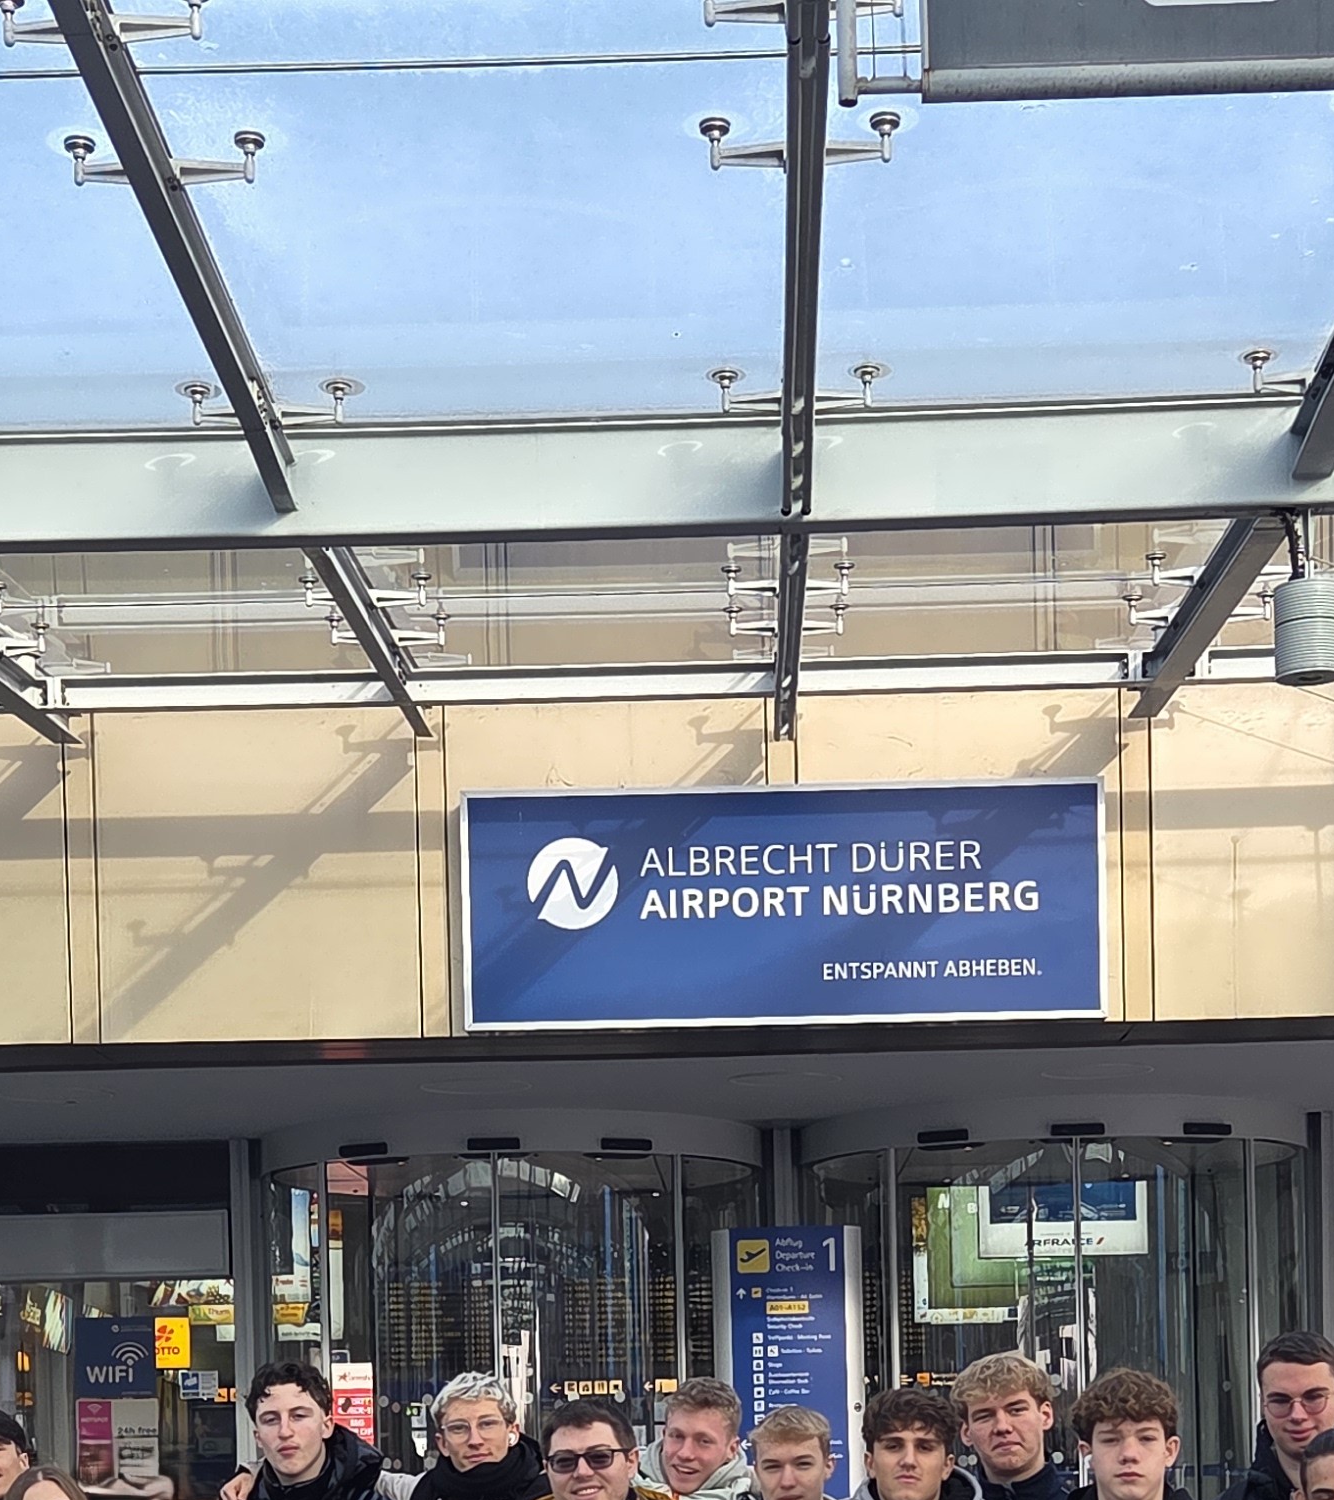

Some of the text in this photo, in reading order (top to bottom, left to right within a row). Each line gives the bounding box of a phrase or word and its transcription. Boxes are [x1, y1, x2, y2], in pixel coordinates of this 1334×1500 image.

[640, 840, 983, 877] ALBRECHT DÜRER
[640, 880, 1040, 920] AIRPORT NÜRNBERG
[822, 958, 1043, 980] ENTSPANNT ABHEBEN.
[822, 1237, 836, 1272] 1
